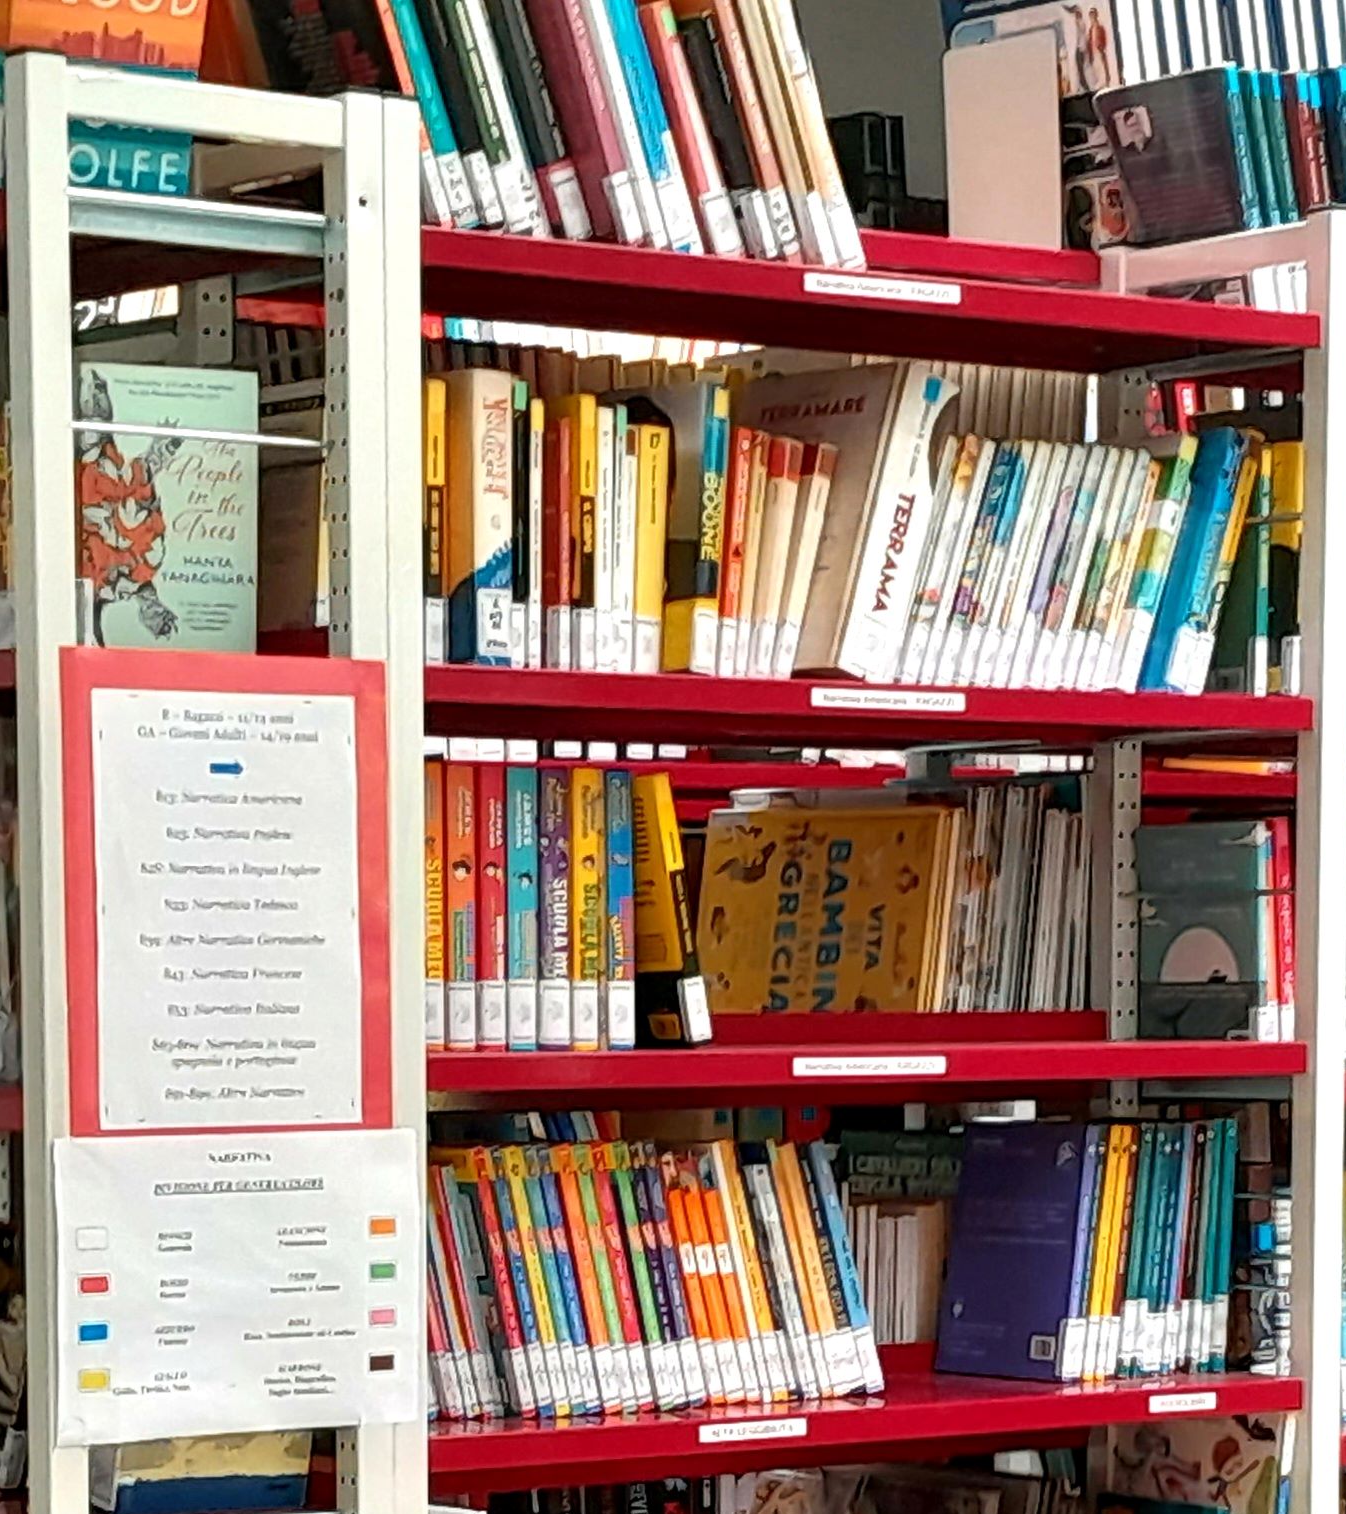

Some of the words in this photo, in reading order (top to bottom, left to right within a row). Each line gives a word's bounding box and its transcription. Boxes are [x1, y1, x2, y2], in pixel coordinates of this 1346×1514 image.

[68, 141, 183, 193] OLFE
[166, 455, 244, 490] People
[172, 508, 240, 542] Trees
[218, 493, 246, 518] the
[871, 493, 917, 613] TERRAMA
[553, 877, 568, 947] SCUOLA
[768, 858, 804, 1012] GRECIA
[810, 838, 853, 1012] BAMBIN
